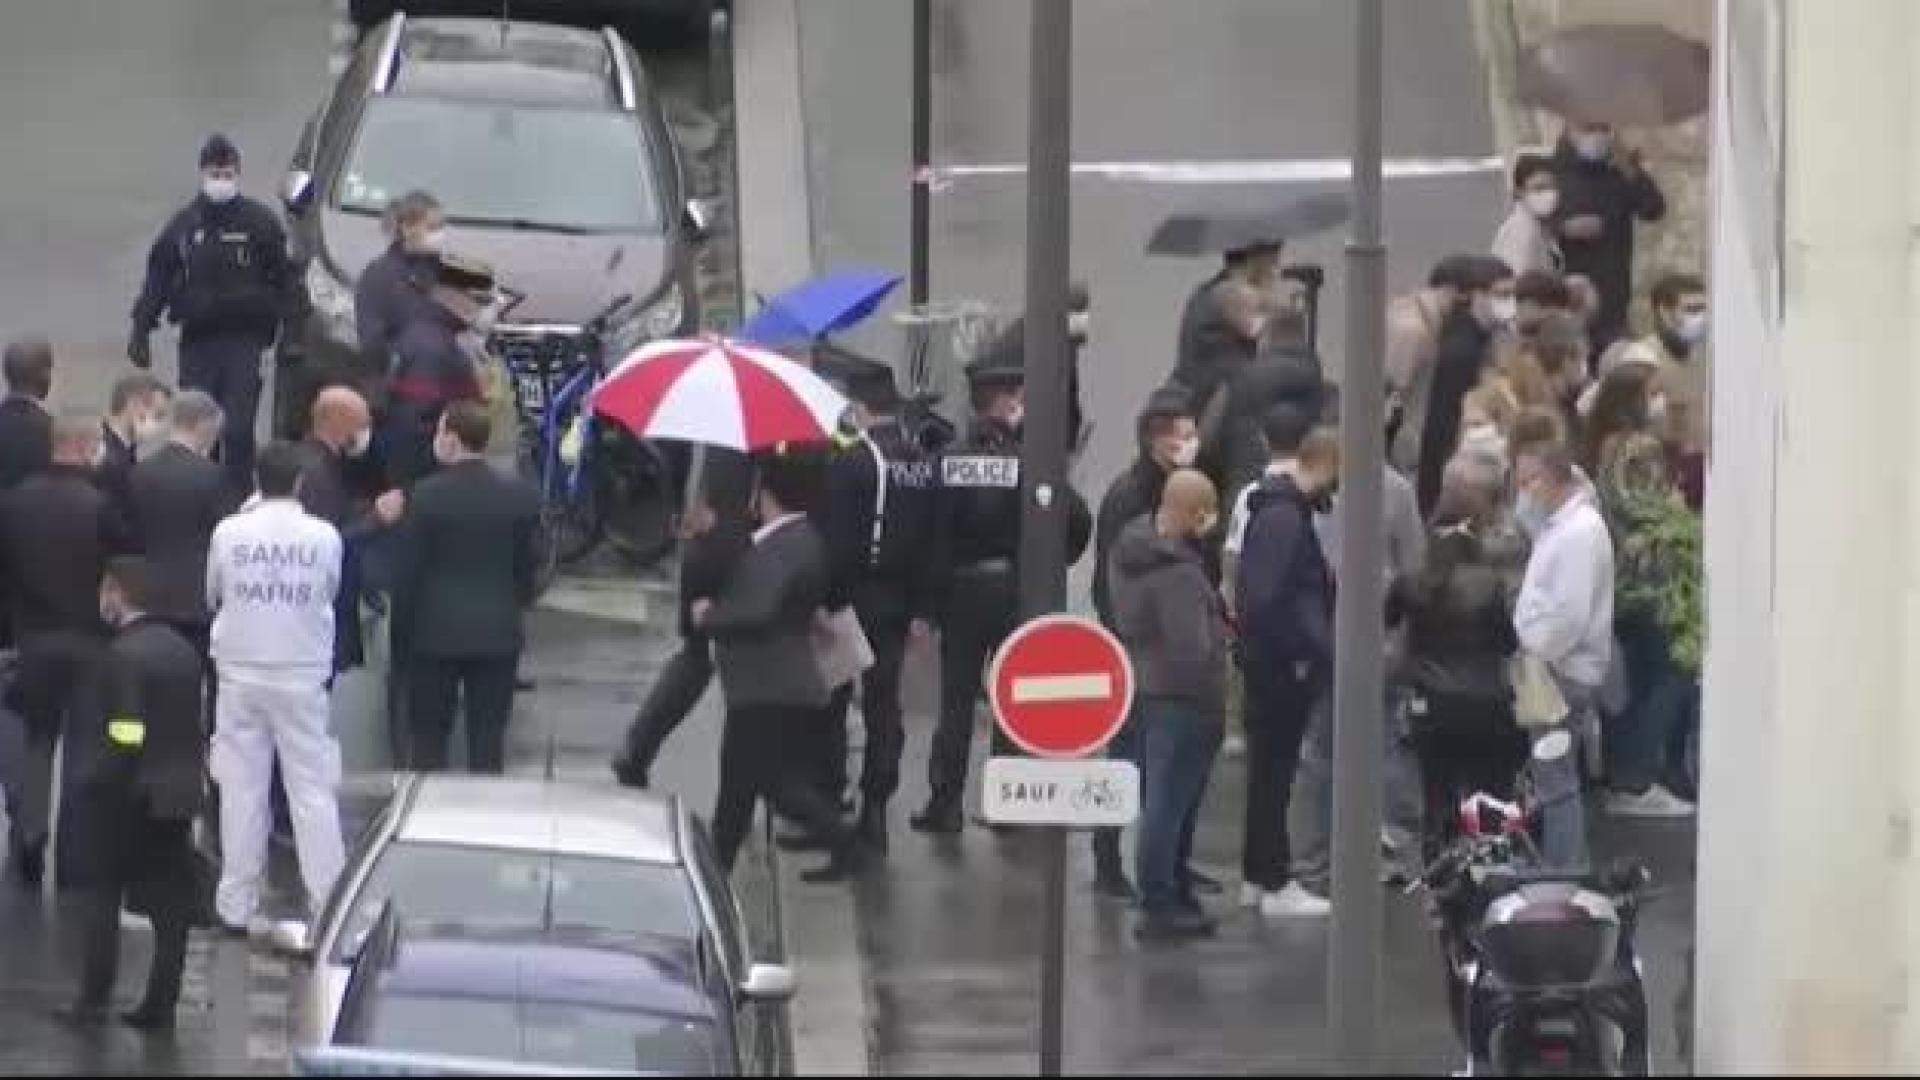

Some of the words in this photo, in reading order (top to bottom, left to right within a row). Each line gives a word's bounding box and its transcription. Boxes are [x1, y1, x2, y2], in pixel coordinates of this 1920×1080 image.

[946, 459, 1015, 482] POLICE
[232, 544, 318, 567] SAMU
[234, 583, 312, 606] PARIS
[1001, 782, 1058, 802] SAUF
